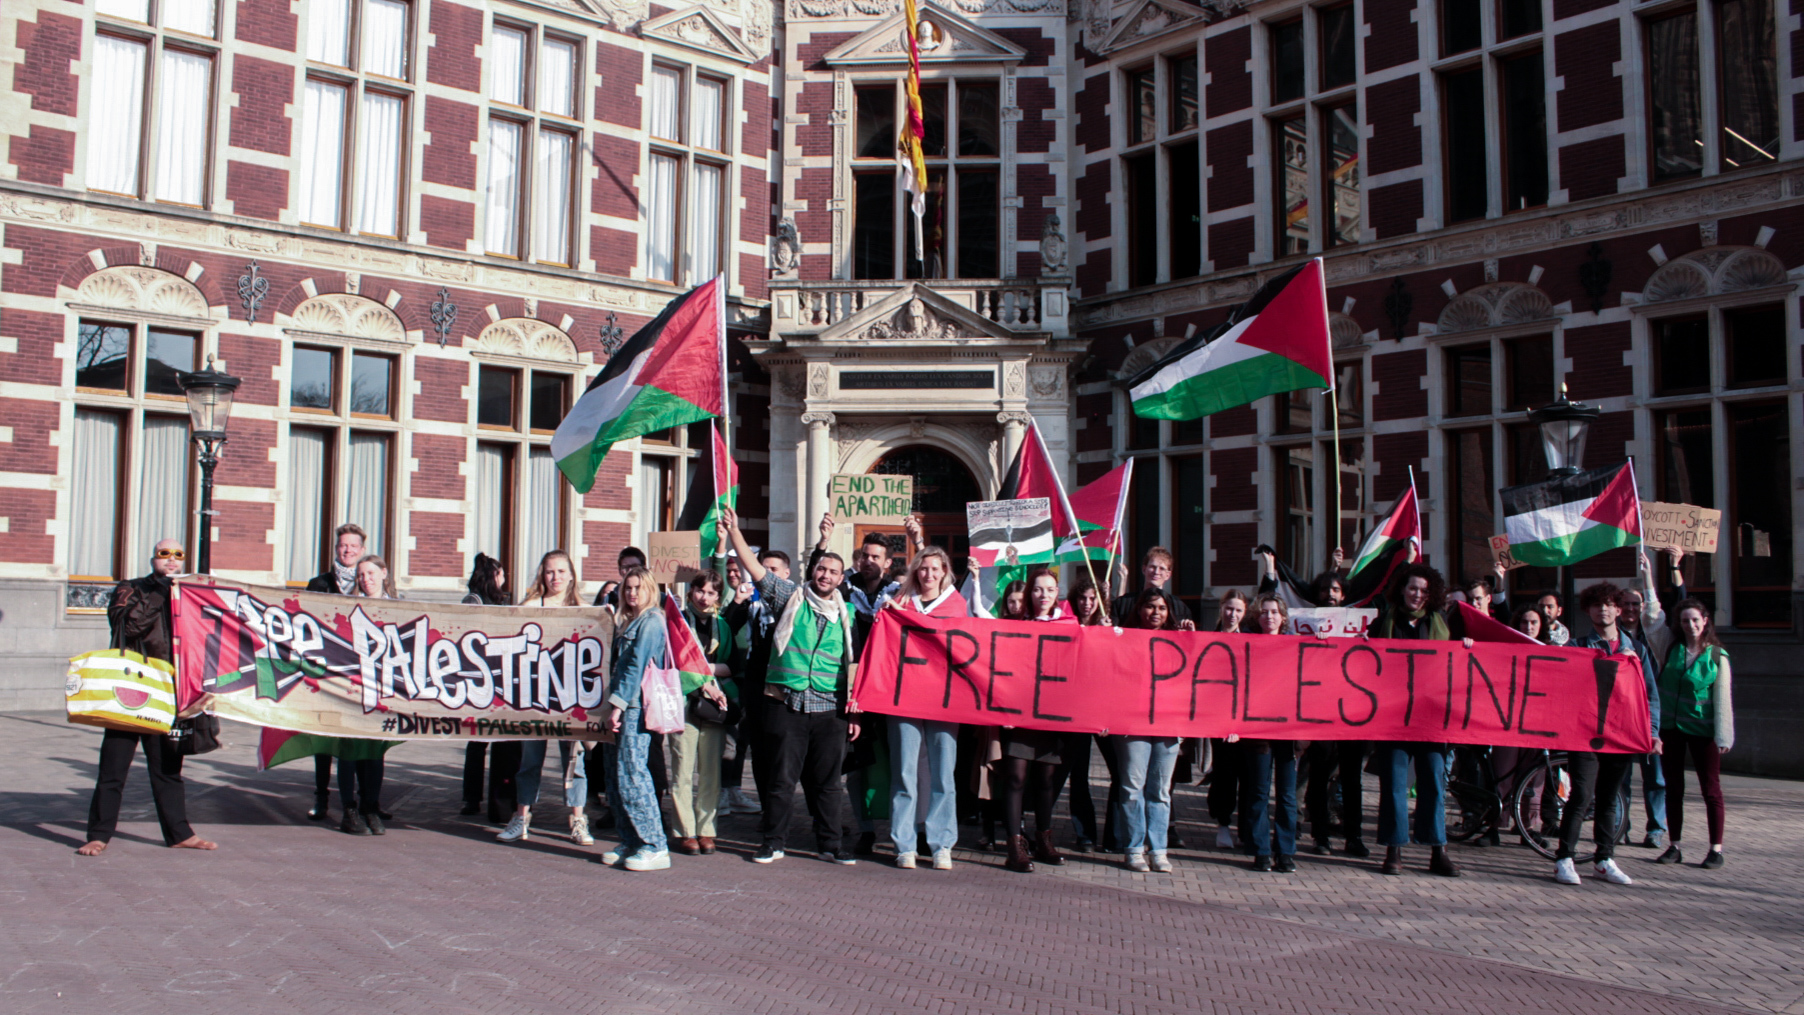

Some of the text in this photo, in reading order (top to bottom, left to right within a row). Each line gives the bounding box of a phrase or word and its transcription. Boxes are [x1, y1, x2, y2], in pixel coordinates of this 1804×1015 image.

[833, 475, 911, 495] END THE
[834, 494, 911, 518] APARTHEID
[650, 545, 699, 559] DIVEST
[653, 559, 699, 574] NOW!
[893, 625, 1073, 722] FREE
[1149, 637, 1567, 738] PALESTINE
[136, 714, 162, 725] JUMBO
